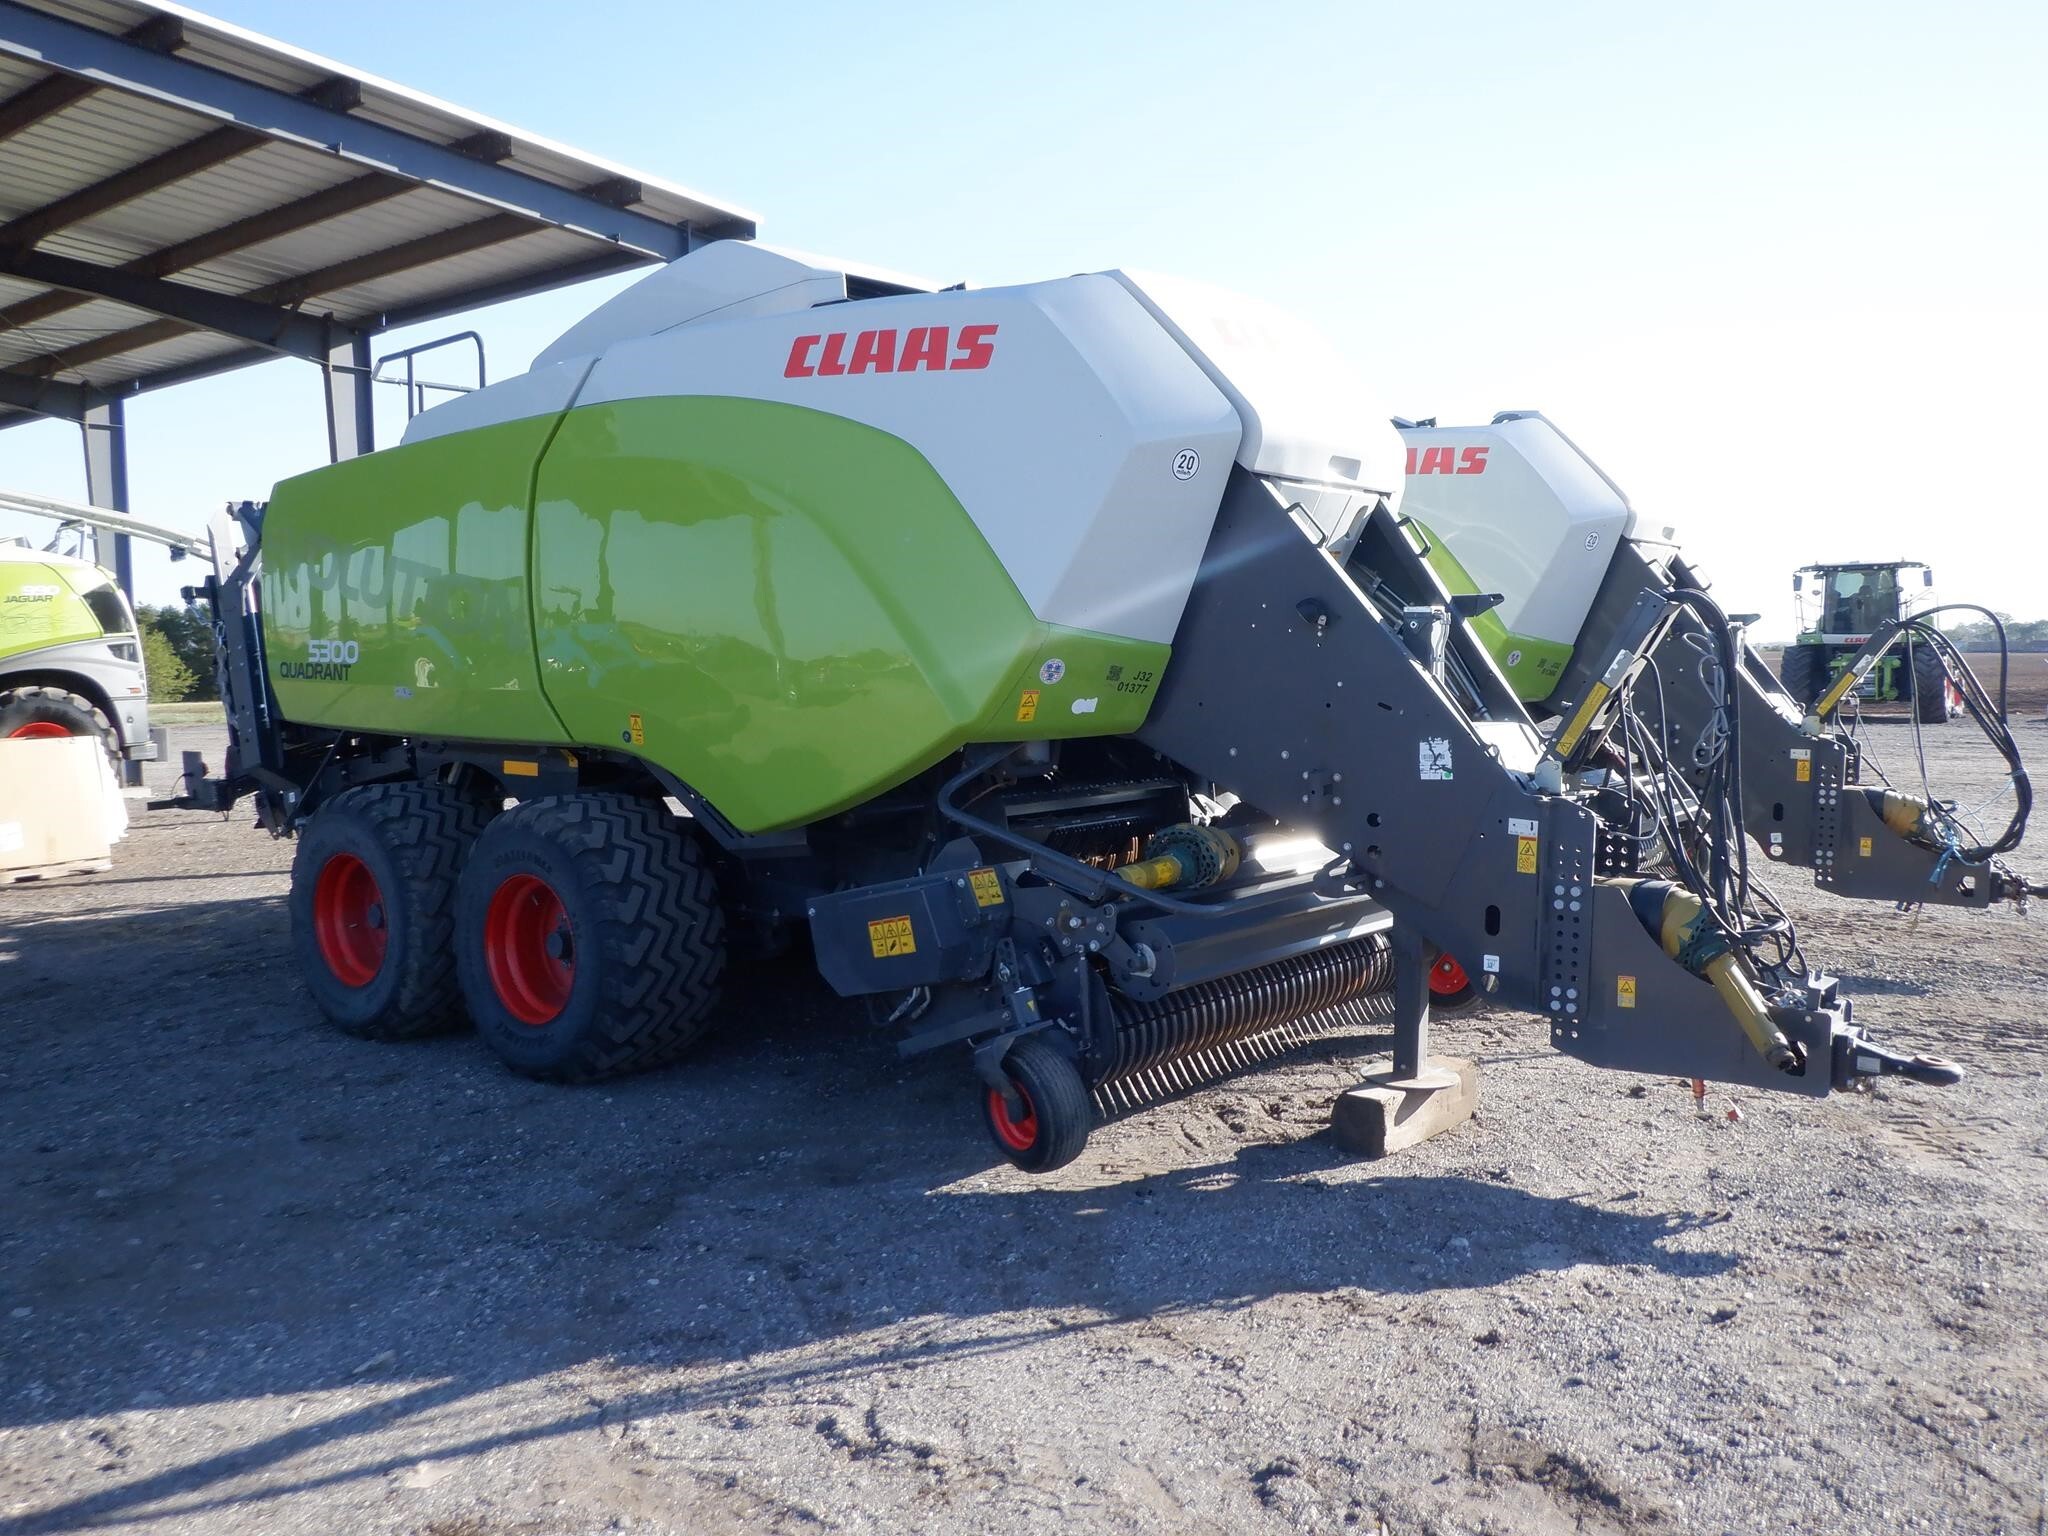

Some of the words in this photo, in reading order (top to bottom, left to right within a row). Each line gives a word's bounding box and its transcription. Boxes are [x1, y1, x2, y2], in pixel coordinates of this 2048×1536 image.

[784, 324, 999, 378] CLAAS
[1177, 454, 1195, 470] 20
[3, 595, 54, 603] JAGUAR
[307, 640, 359, 664] 5300
[280, 662, 352, 681] QUADRANT
[1133, 671, 1153, 682] J32
[1117, 681, 1148, 694] 01377
